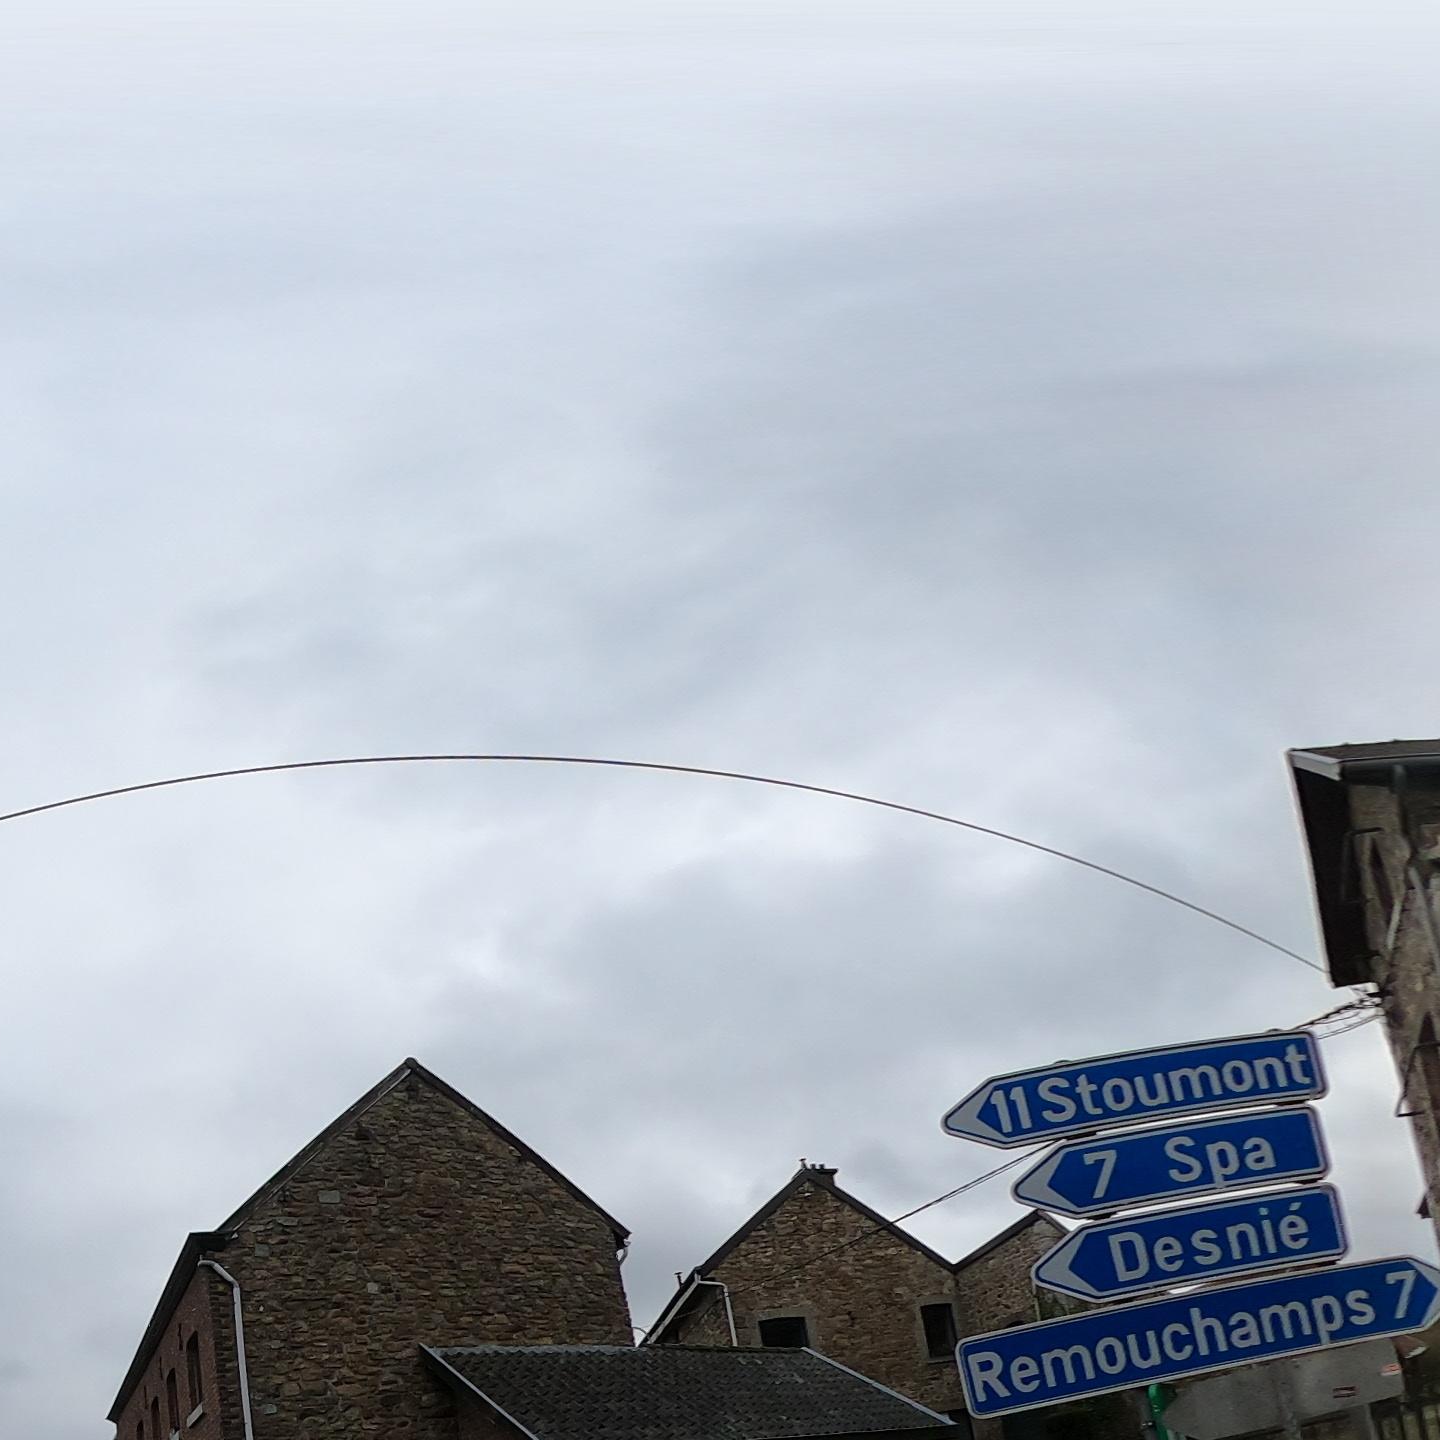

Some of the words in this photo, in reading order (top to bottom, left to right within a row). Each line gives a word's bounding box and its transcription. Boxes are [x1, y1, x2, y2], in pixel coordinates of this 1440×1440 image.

[990, 1087, 1034, 1135] 11
[1041, 1044, 1311, 1125] Stoumont
[1083, 1149, 1117, 1199] 7
[1166, 1137, 1276, 1189] Spa
[1110, 1203, 1309, 1282] Desnié
[968, 1288, 1375, 1403] Remouchamps
[1385, 1271, 1418, 1321] 7
